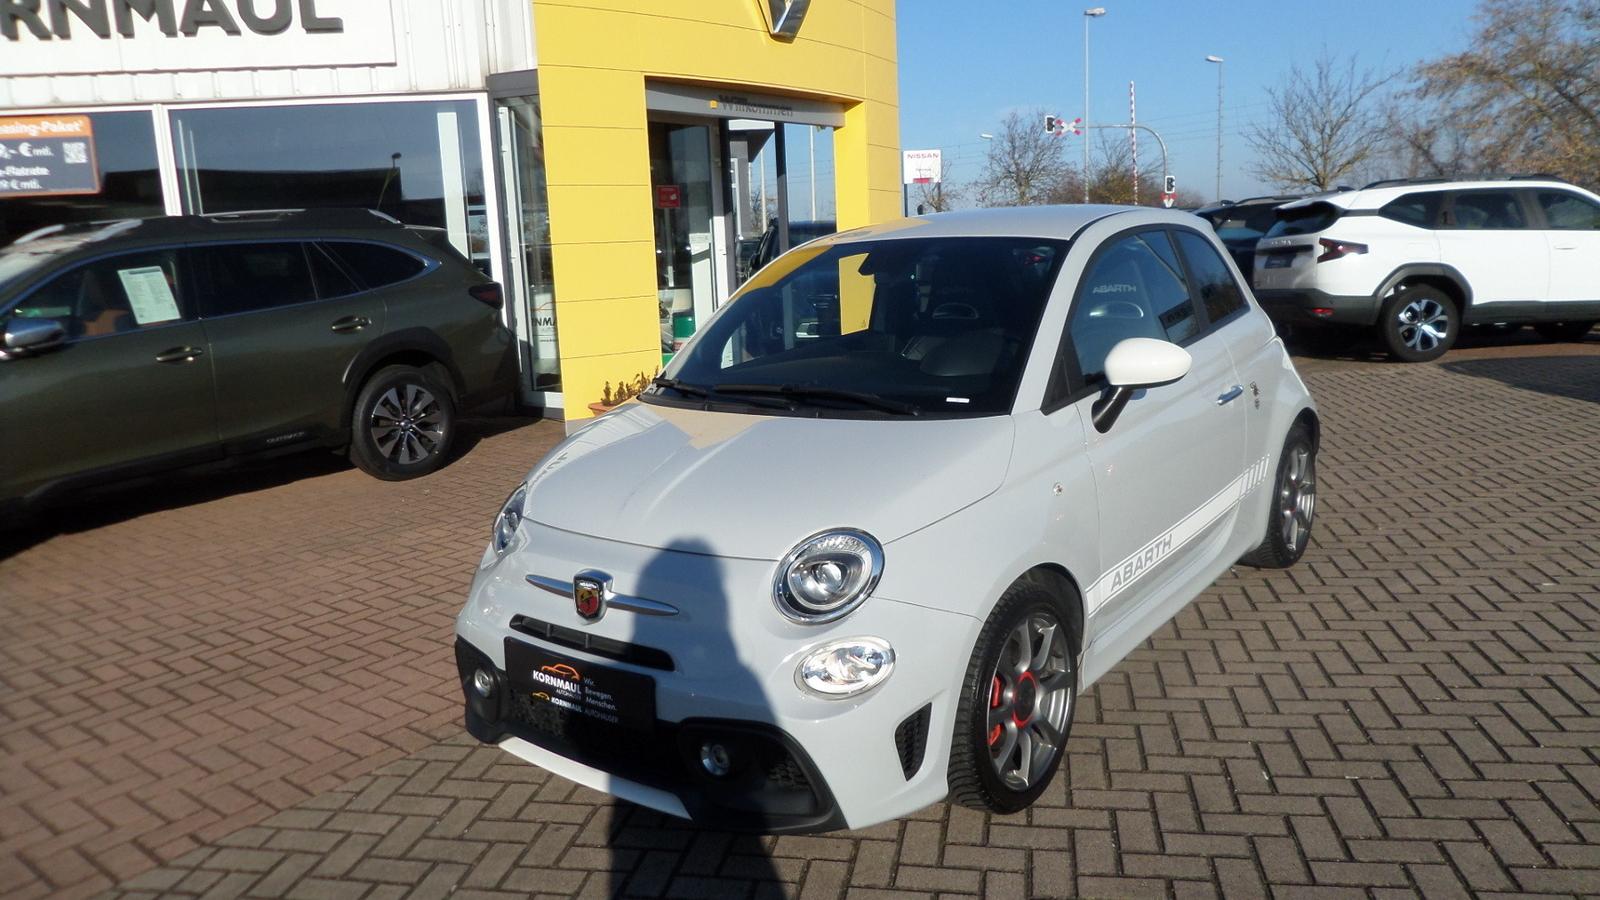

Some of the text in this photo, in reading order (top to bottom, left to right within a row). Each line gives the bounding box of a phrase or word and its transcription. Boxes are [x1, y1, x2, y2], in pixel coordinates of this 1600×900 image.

[1092, 283, 1137, 294] ABARTH
[1110, 533, 1173, 592] ABARTH
[532, 670, 582, 694] KORNMAUL
[551, 697, 582, 713] KORNMAUL
